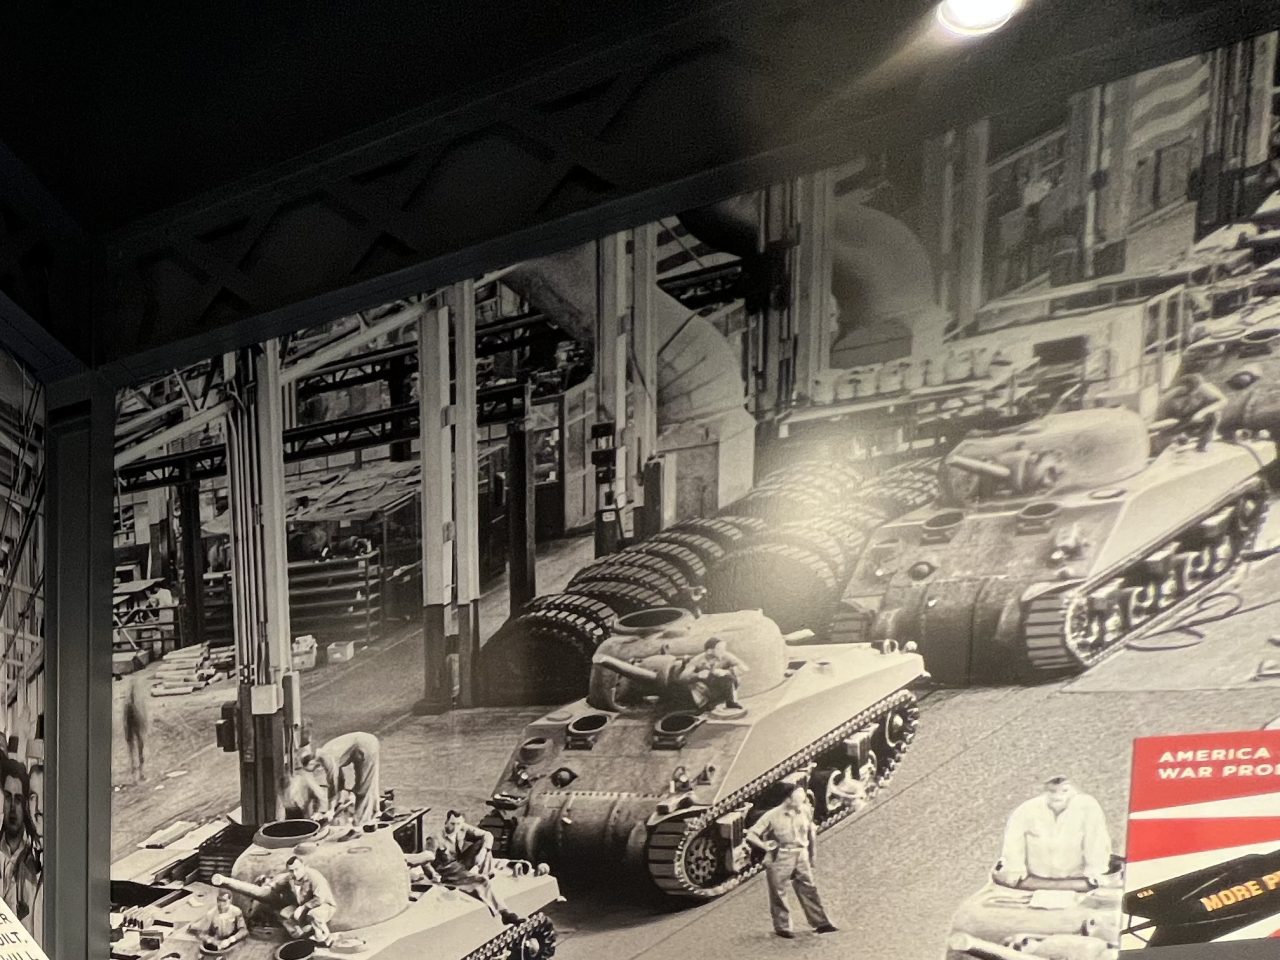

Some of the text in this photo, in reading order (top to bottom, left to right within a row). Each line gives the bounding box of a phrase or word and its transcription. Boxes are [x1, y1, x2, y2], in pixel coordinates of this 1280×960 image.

[1158, 748, 1271, 763] AMERICA
[1158, 766, 1213, 779] WAR
[1200, 880, 1264, 911] MORE
